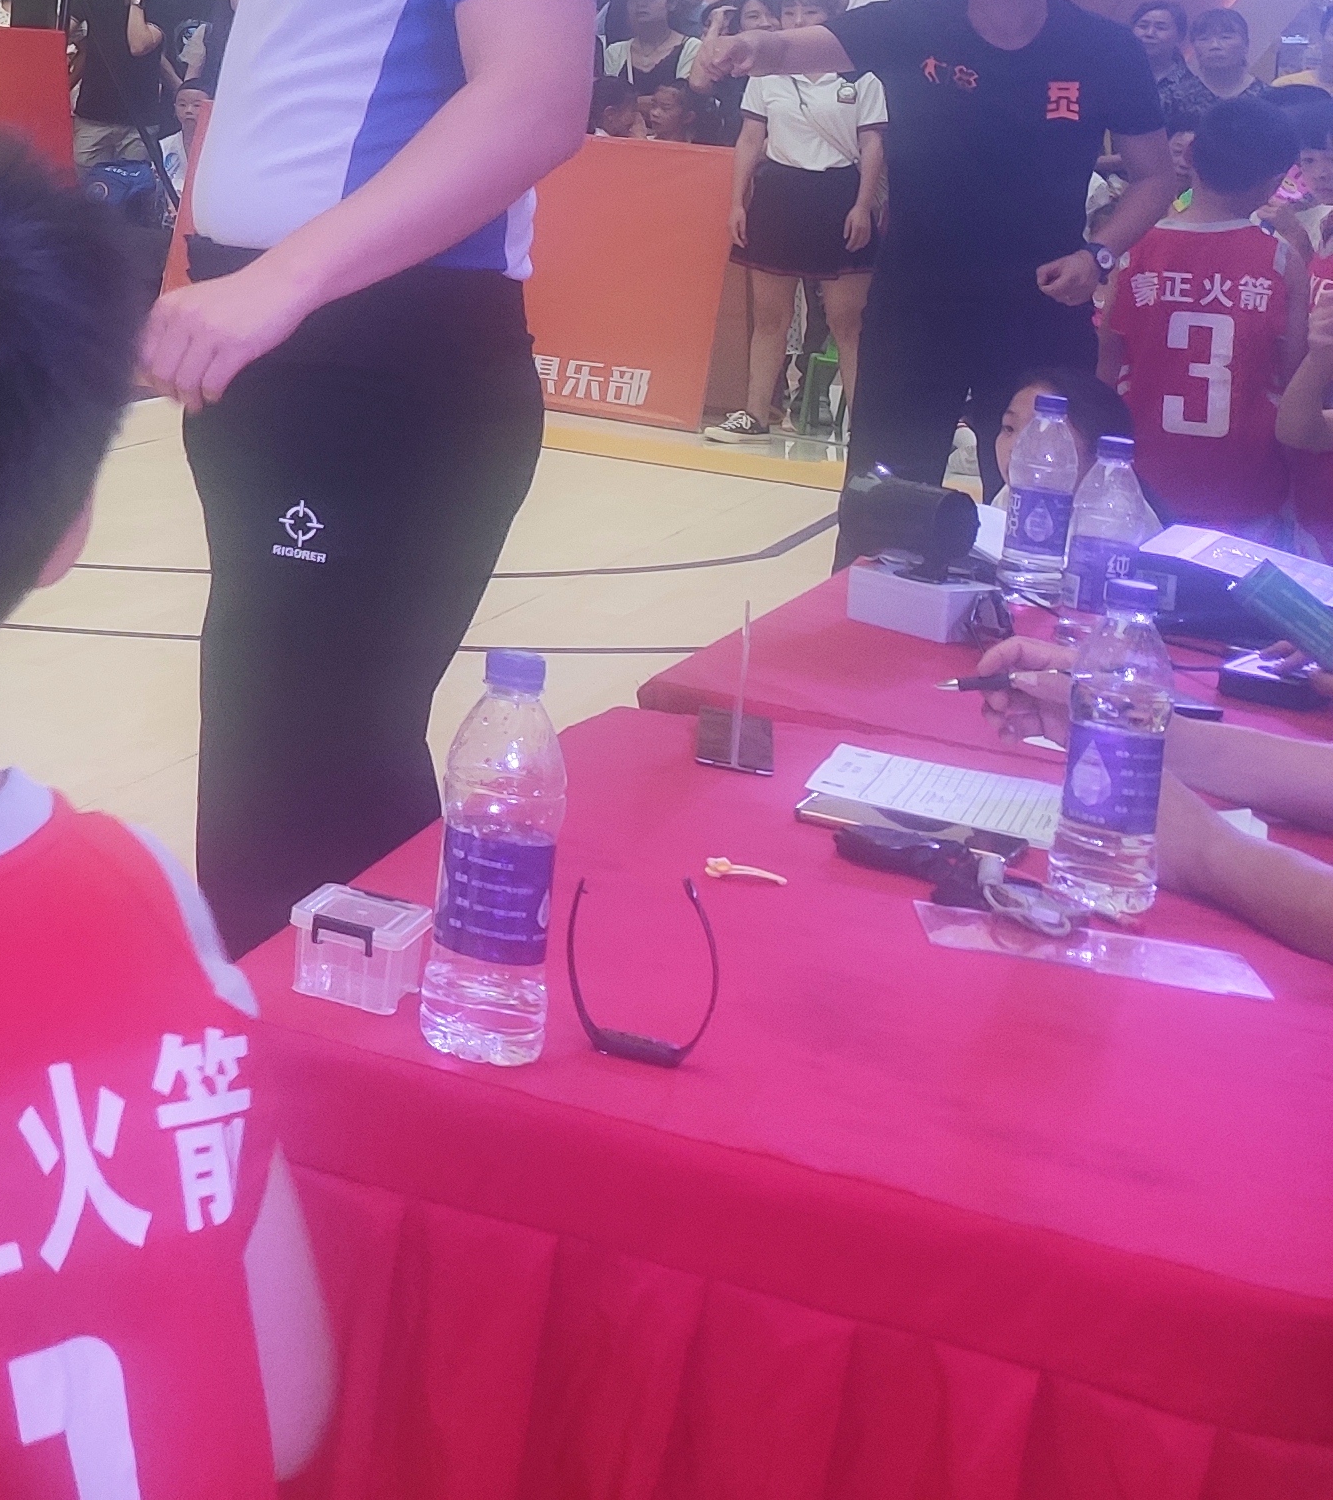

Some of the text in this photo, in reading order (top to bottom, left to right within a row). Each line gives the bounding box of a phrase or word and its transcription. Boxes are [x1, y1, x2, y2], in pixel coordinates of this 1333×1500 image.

[1130, 271, 1273, 312] 蒙正火箭
[1162, 310, 1235, 438] 3
[272, 543, 327, 564] RIGORER
